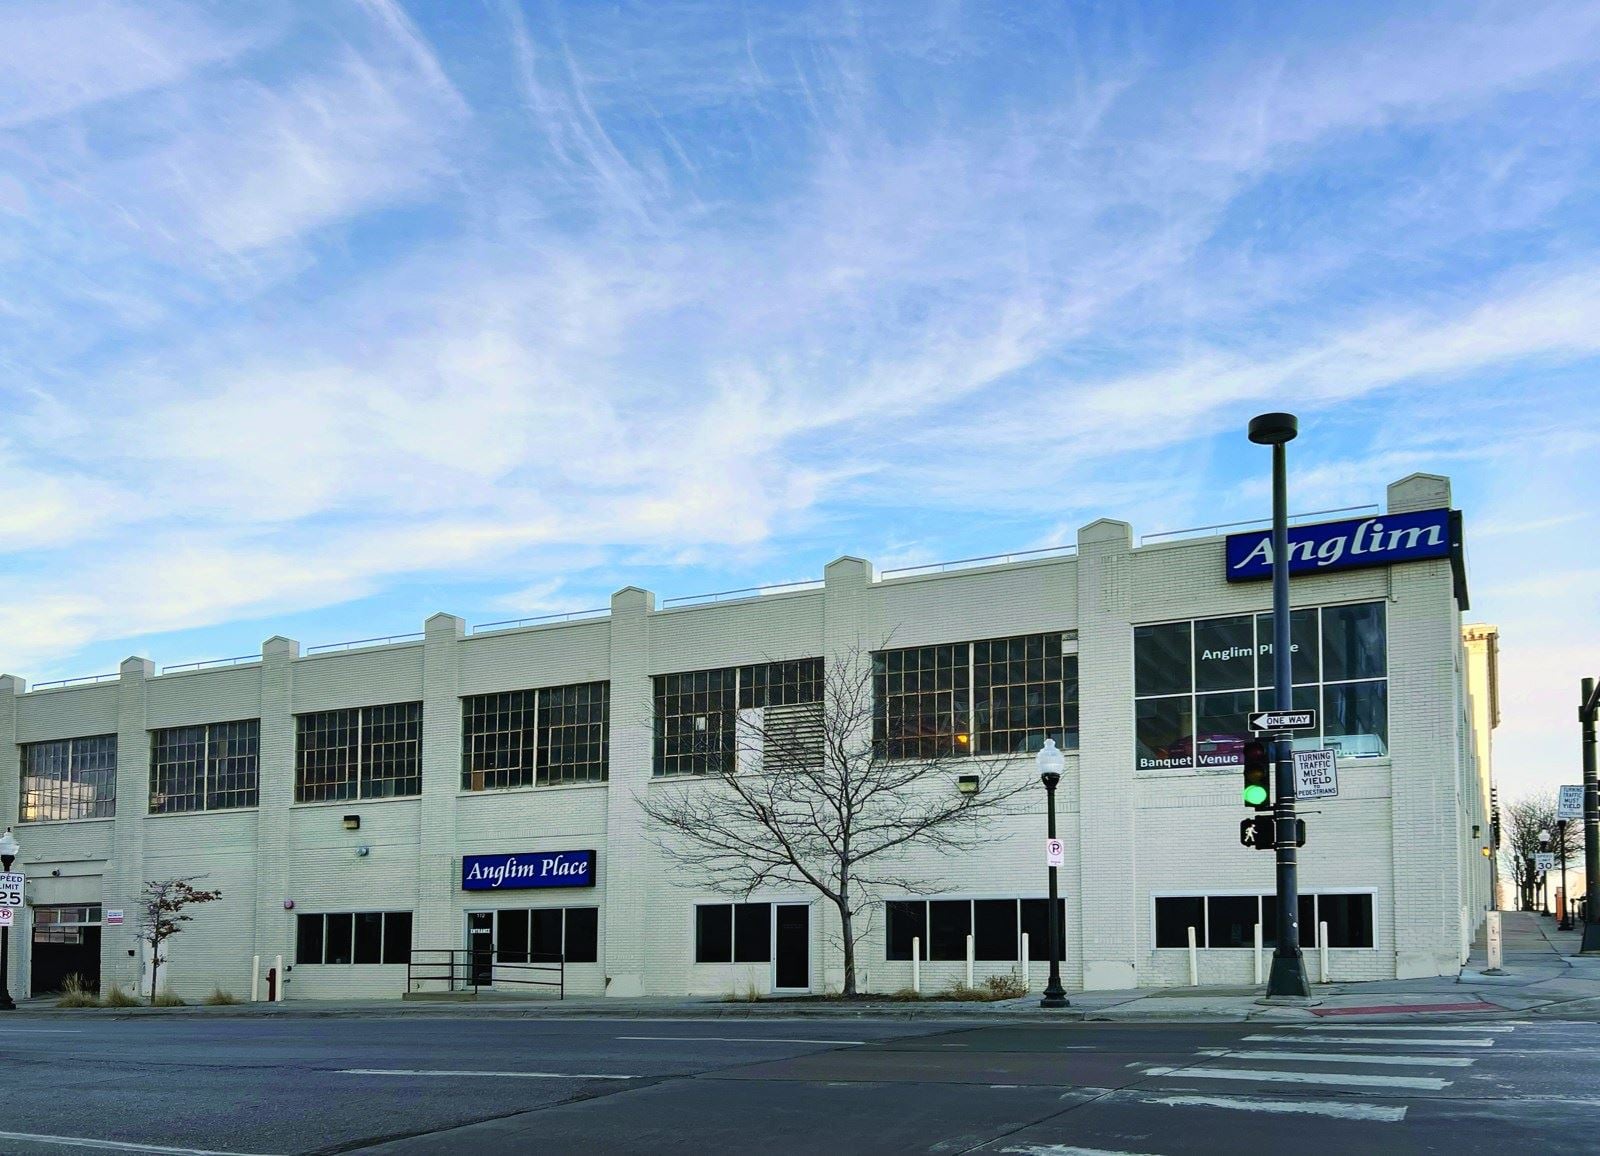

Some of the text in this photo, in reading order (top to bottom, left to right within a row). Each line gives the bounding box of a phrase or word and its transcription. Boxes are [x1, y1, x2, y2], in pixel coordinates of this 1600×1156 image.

[1233, 519, 1444, 568] Anglim
[1201, 643, 1299, 661] Anglim Ple
[1266, 714, 1308, 725] ONE WAY
[1140, 754, 1238, 768] Banquet Venue
[1298, 752, 1331, 762] TURNING
[1300, 760, 1331, 769] TRAFFIC
[1303, 768, 1327, 777] MUST
[1301, 776, 1332, 785] YIELD
[1298, 787, 1336, 796] PEDESTRIANS
[466, 855, 588, 887] Anglim Place
[1538, 862, 1552, 870] 30
[0, 875, 23, 883] PEED
[0, 891, 21, 905] 25
